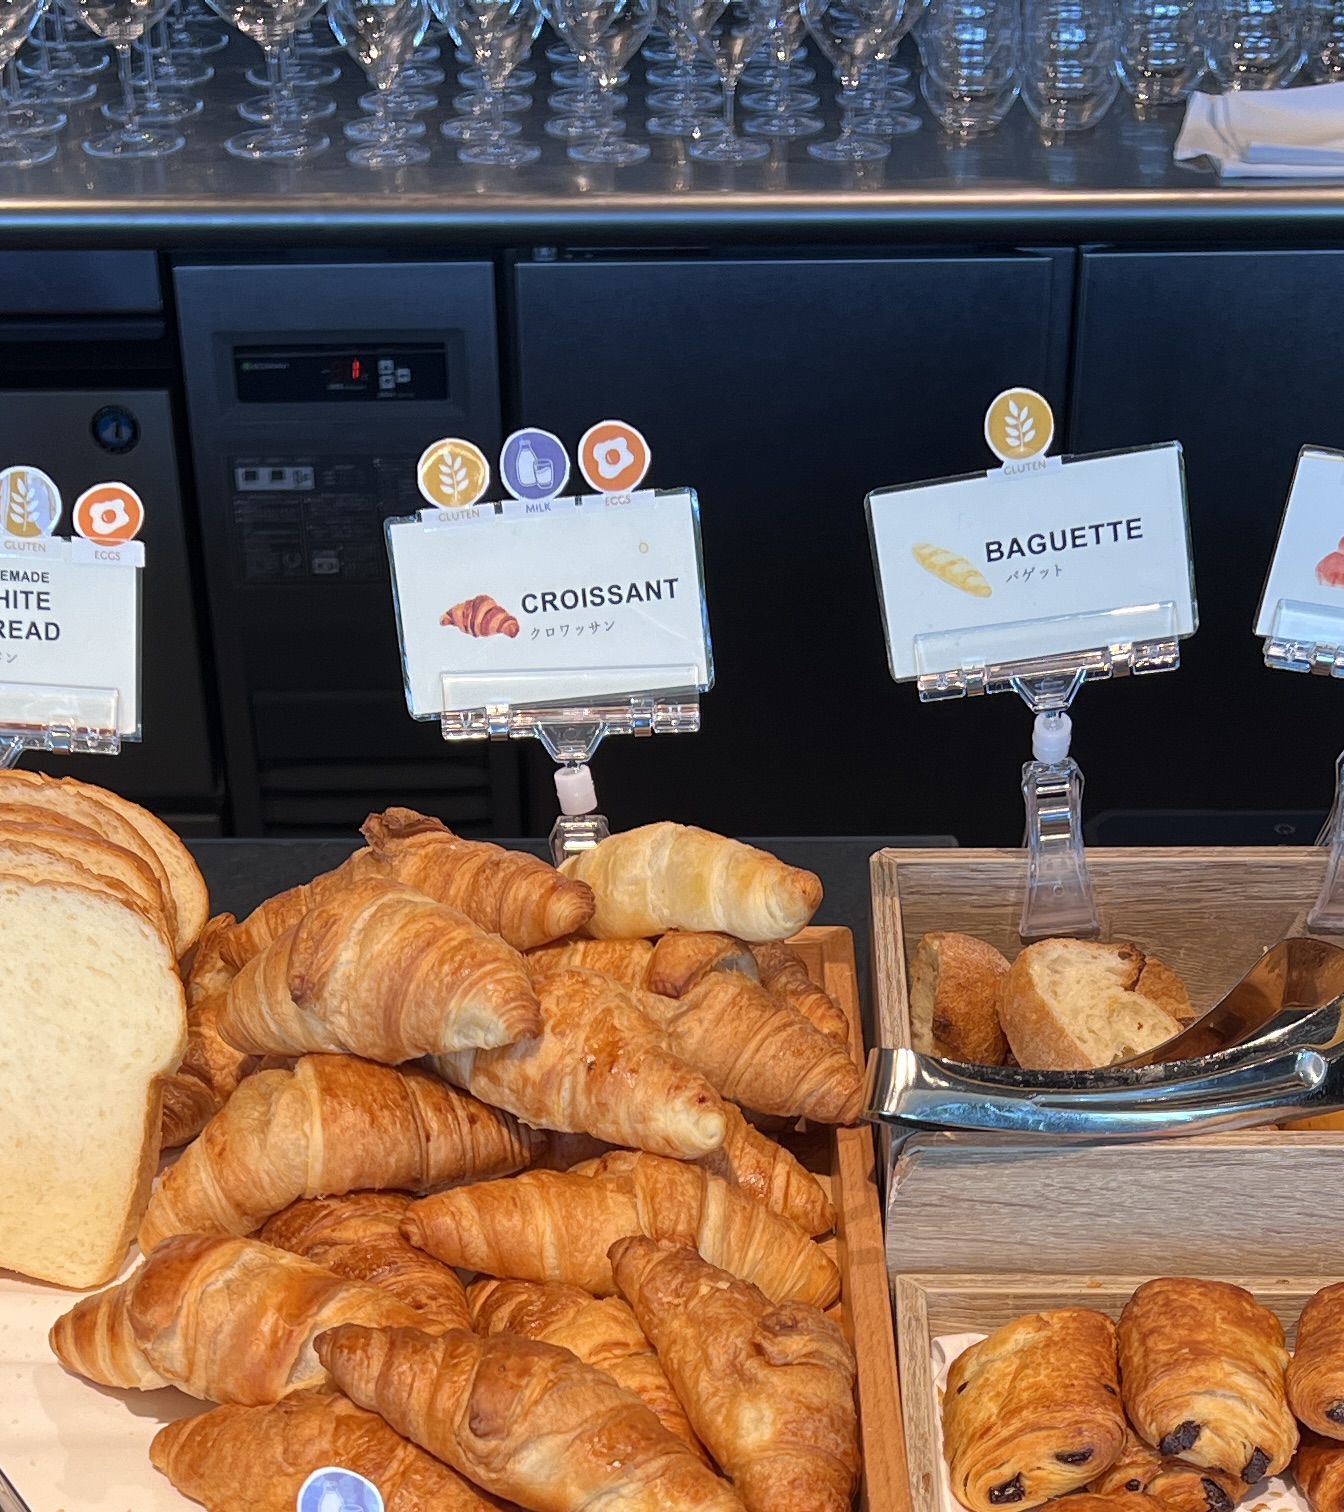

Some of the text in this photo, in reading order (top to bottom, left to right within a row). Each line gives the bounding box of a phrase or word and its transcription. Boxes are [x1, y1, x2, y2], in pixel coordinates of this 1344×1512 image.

[1003, 460, 1047, 477] GLUTEN
[525, 502, 551, 514] MILK
[605, 494, 631, 507] EGGS
[438, 508, 480, 523] GLUTEN
[3, 540, 47, 553] GLUTEN
[985, 517, 1144, 563] BAGUETTE
[94, 550, 121, 561] EGGS
[1006, 564, 1063, 583] バゲット
[521, 577, 680, 614] CROISSANT
[530, 620, 615, 641] クロワッサン
